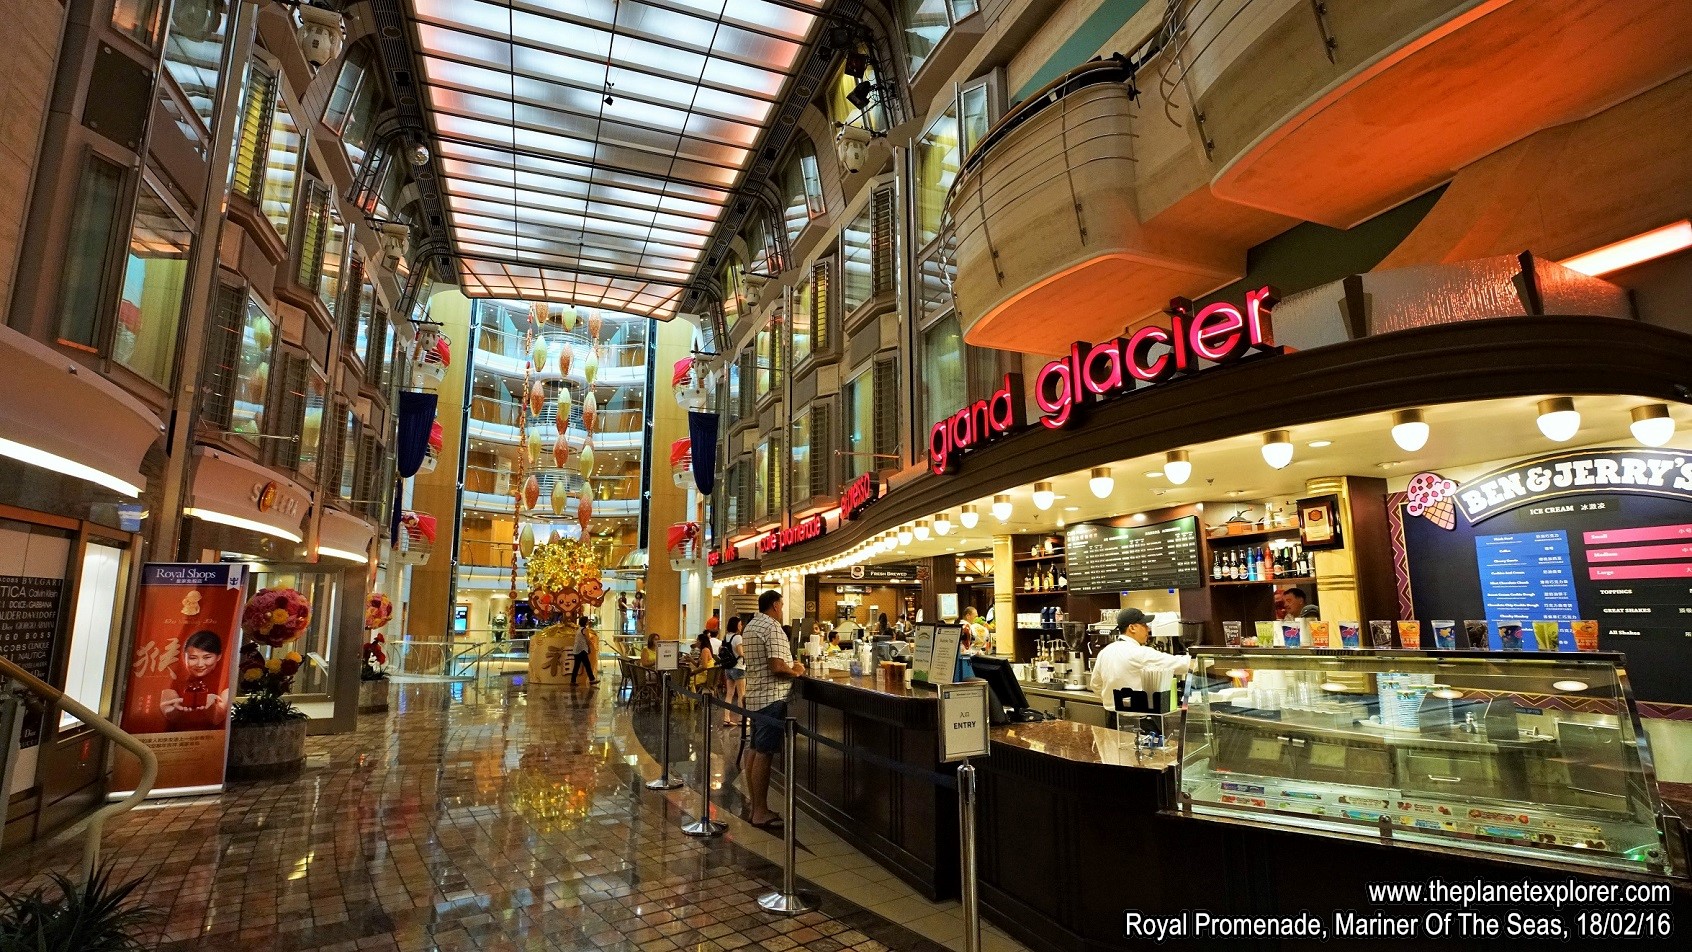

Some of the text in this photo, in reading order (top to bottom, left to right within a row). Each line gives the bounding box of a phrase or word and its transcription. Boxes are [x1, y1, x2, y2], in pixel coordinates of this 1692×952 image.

[930, 285, 1271, 475] grand glacier
[1461, 457, 1692, 515] BEN & JERRY'S
[1529, 505, 1574, 516] ICE CREAM
[156, 568, 216, 580] Royal Shops
[25, 632, 51, 640] BOSS
[18, 651, 46, 660] NAUTICA
[953, 721, 976, 730] ENTRY
